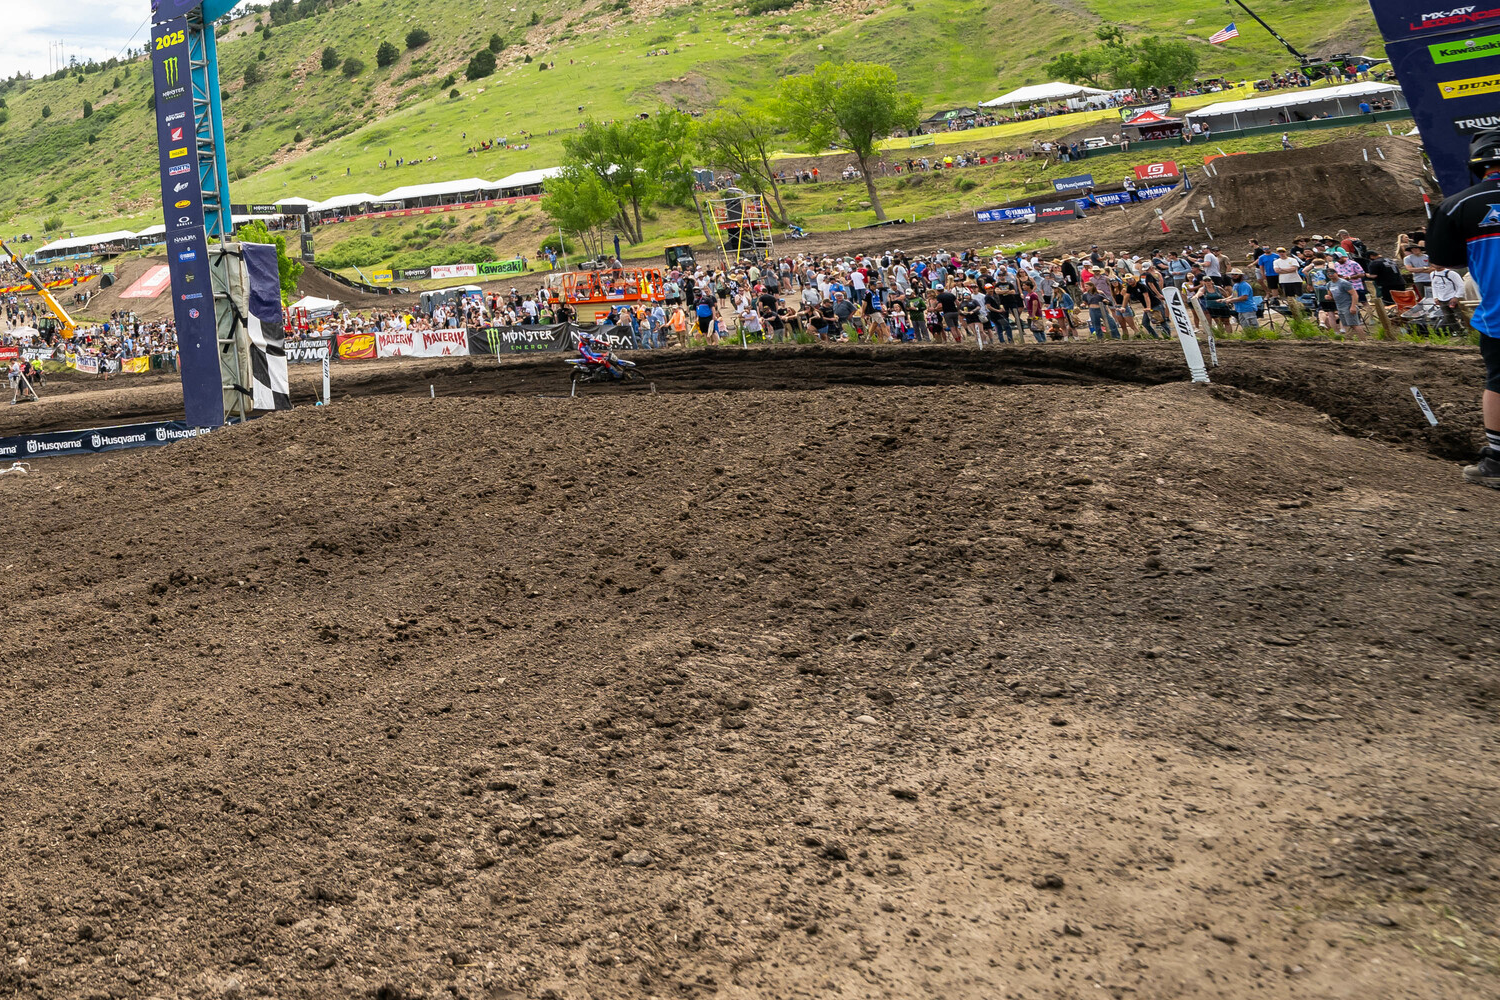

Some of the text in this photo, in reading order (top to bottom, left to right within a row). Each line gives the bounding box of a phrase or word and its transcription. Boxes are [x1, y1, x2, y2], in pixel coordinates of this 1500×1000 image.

[155, 29, 186, 51] 2025
[1145, 186, 1173, 196] YAMAHA
[478, 260, 522, 275] Kawasaki
[378, 331, 466, 351] MAVERIK MAVERIK
[502, 329, 555, 344] MONSTER
[570, 330, 632, 345] NMURA
[344, 334, 376, 355] FMF
[102, 433, 146, 448] Husqvarna
[167, 427, 211, 439] Husqvana
[37, 439, 82, 452] Husqvarna
